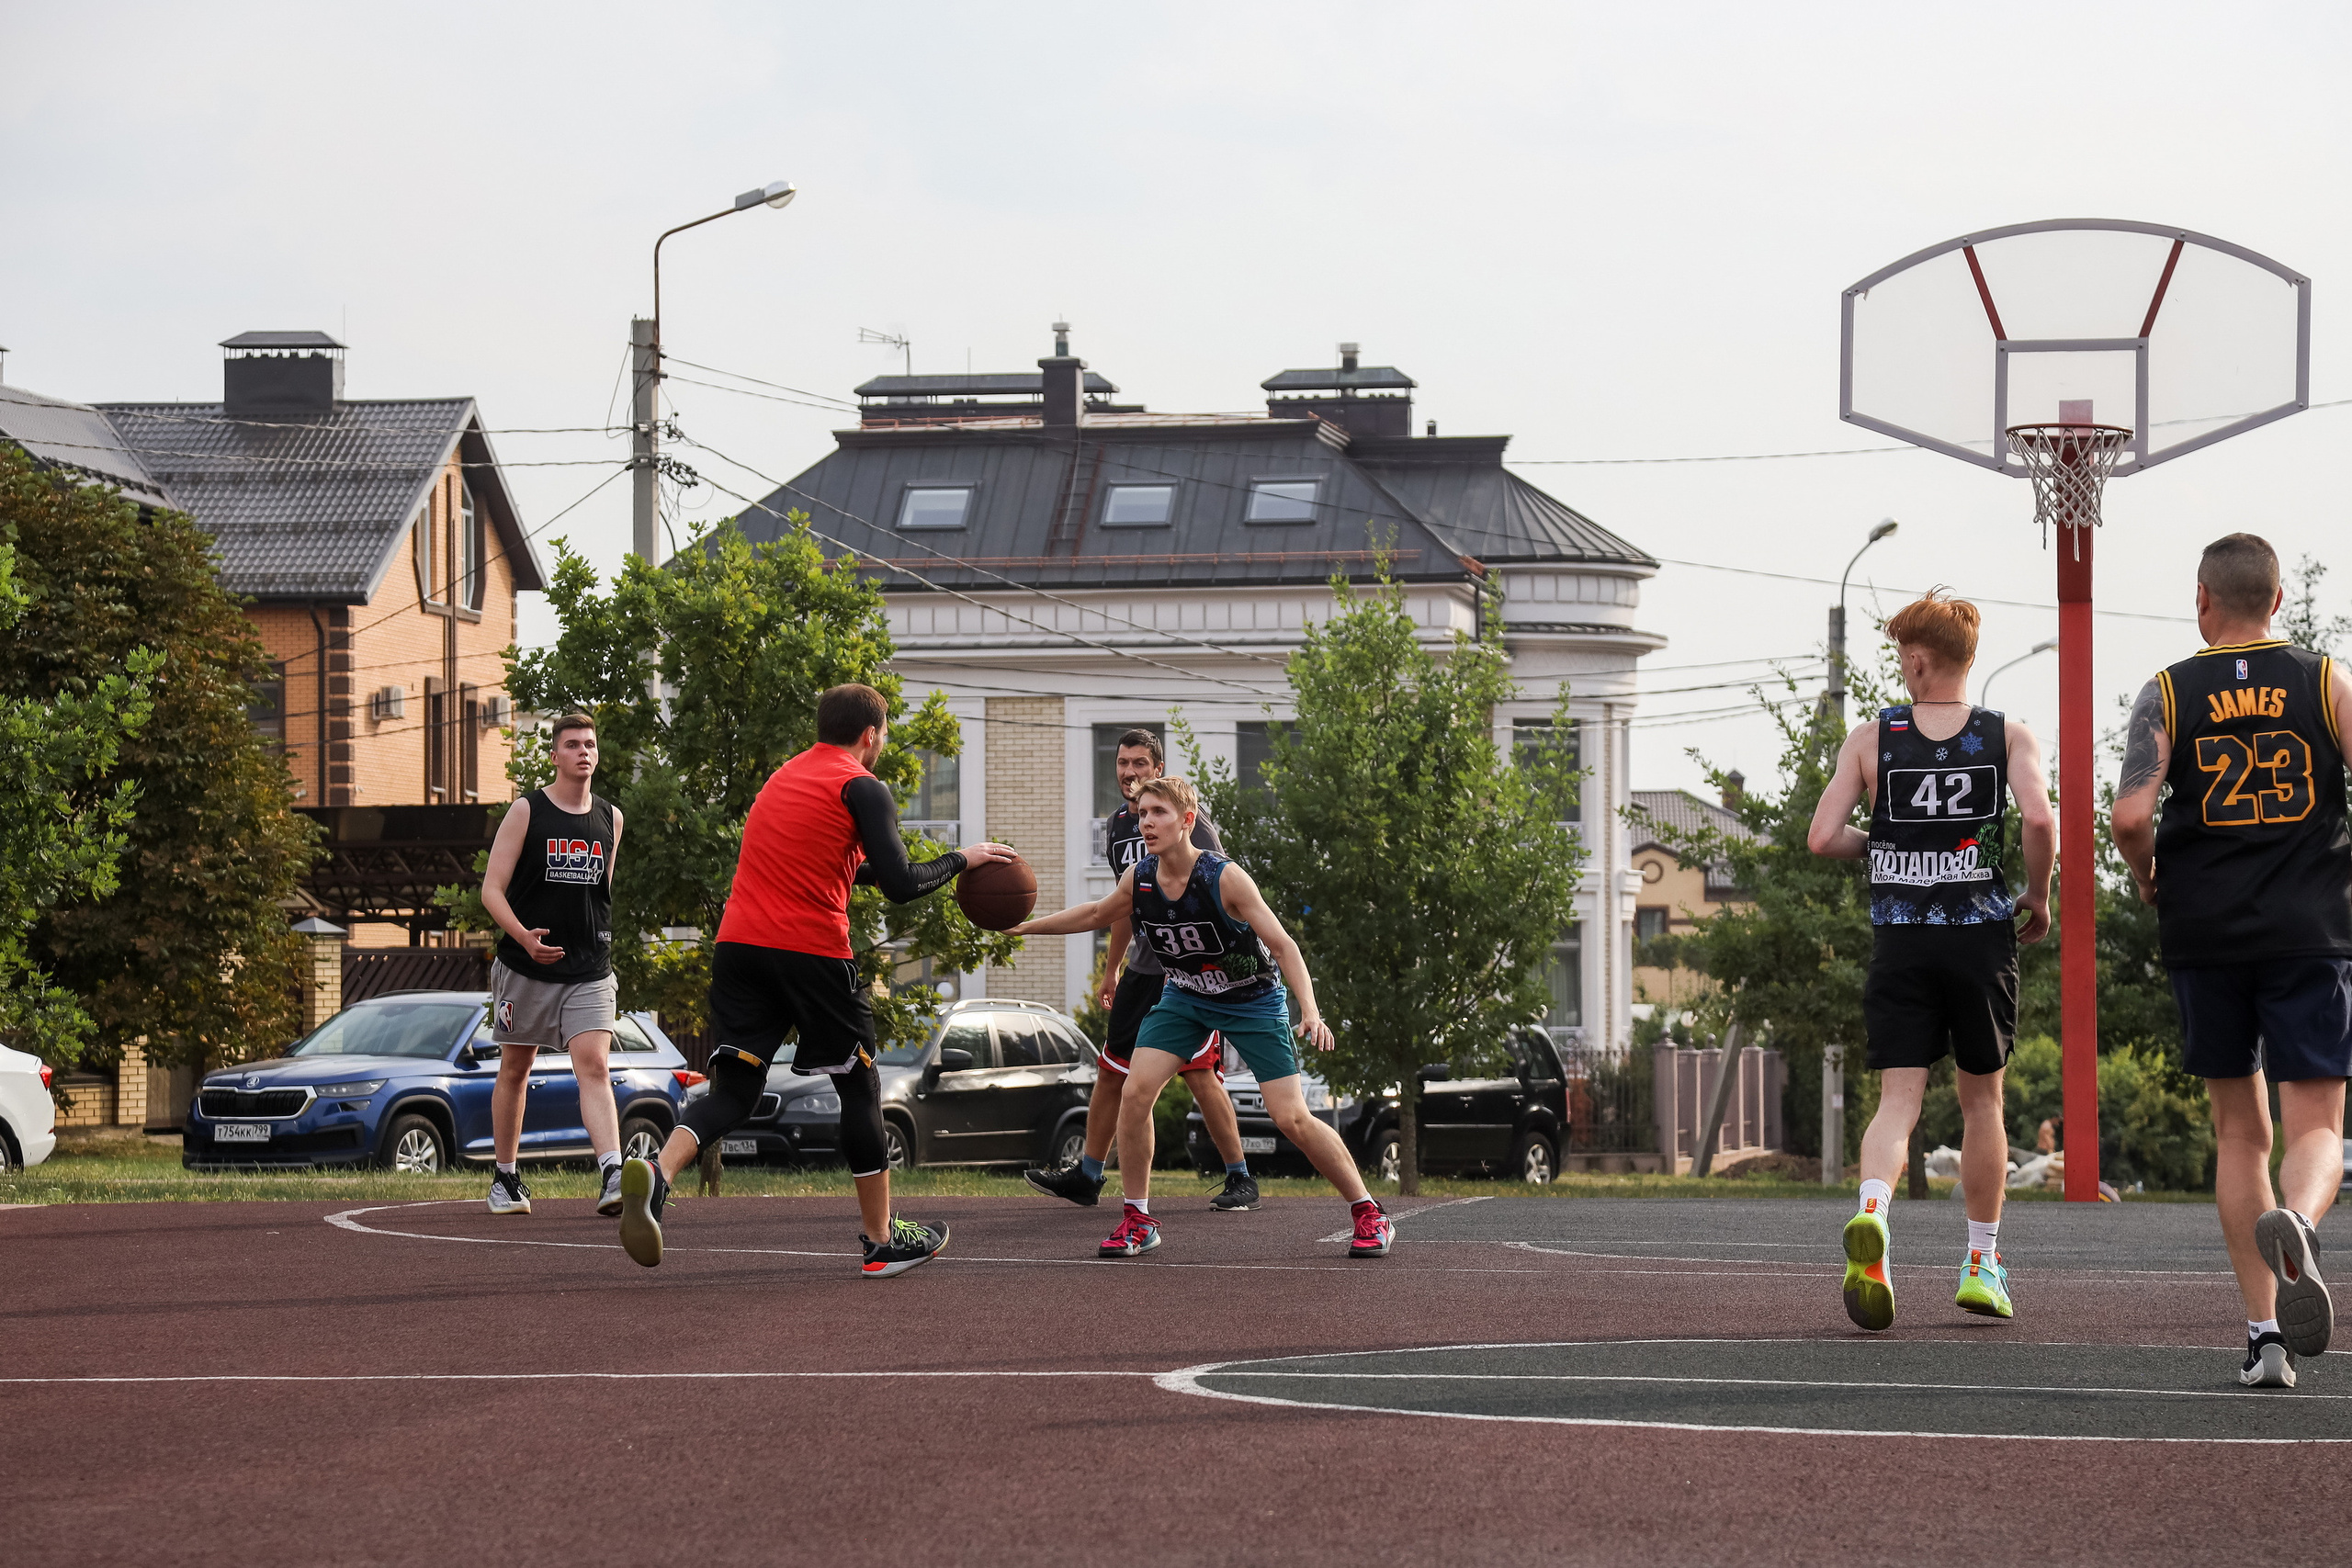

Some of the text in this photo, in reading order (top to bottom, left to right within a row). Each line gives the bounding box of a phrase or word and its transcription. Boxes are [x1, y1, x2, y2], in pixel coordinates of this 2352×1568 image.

[2207, 686, 2288, 723] JAMES
[1910, 773, 1973, 816] 42
[2195, 730, 2316, 827] 23
[547, 839, 605, 871] USA
[1870, 845, 1979, 878] ПОТАПОВО
[1871, 840, 1896, 851] посёлок
[549, 871, 588, 880] BASKETBALL
[1874, 873, 1895, 882] Моя
[1155, 926, 1205, 954] 38
